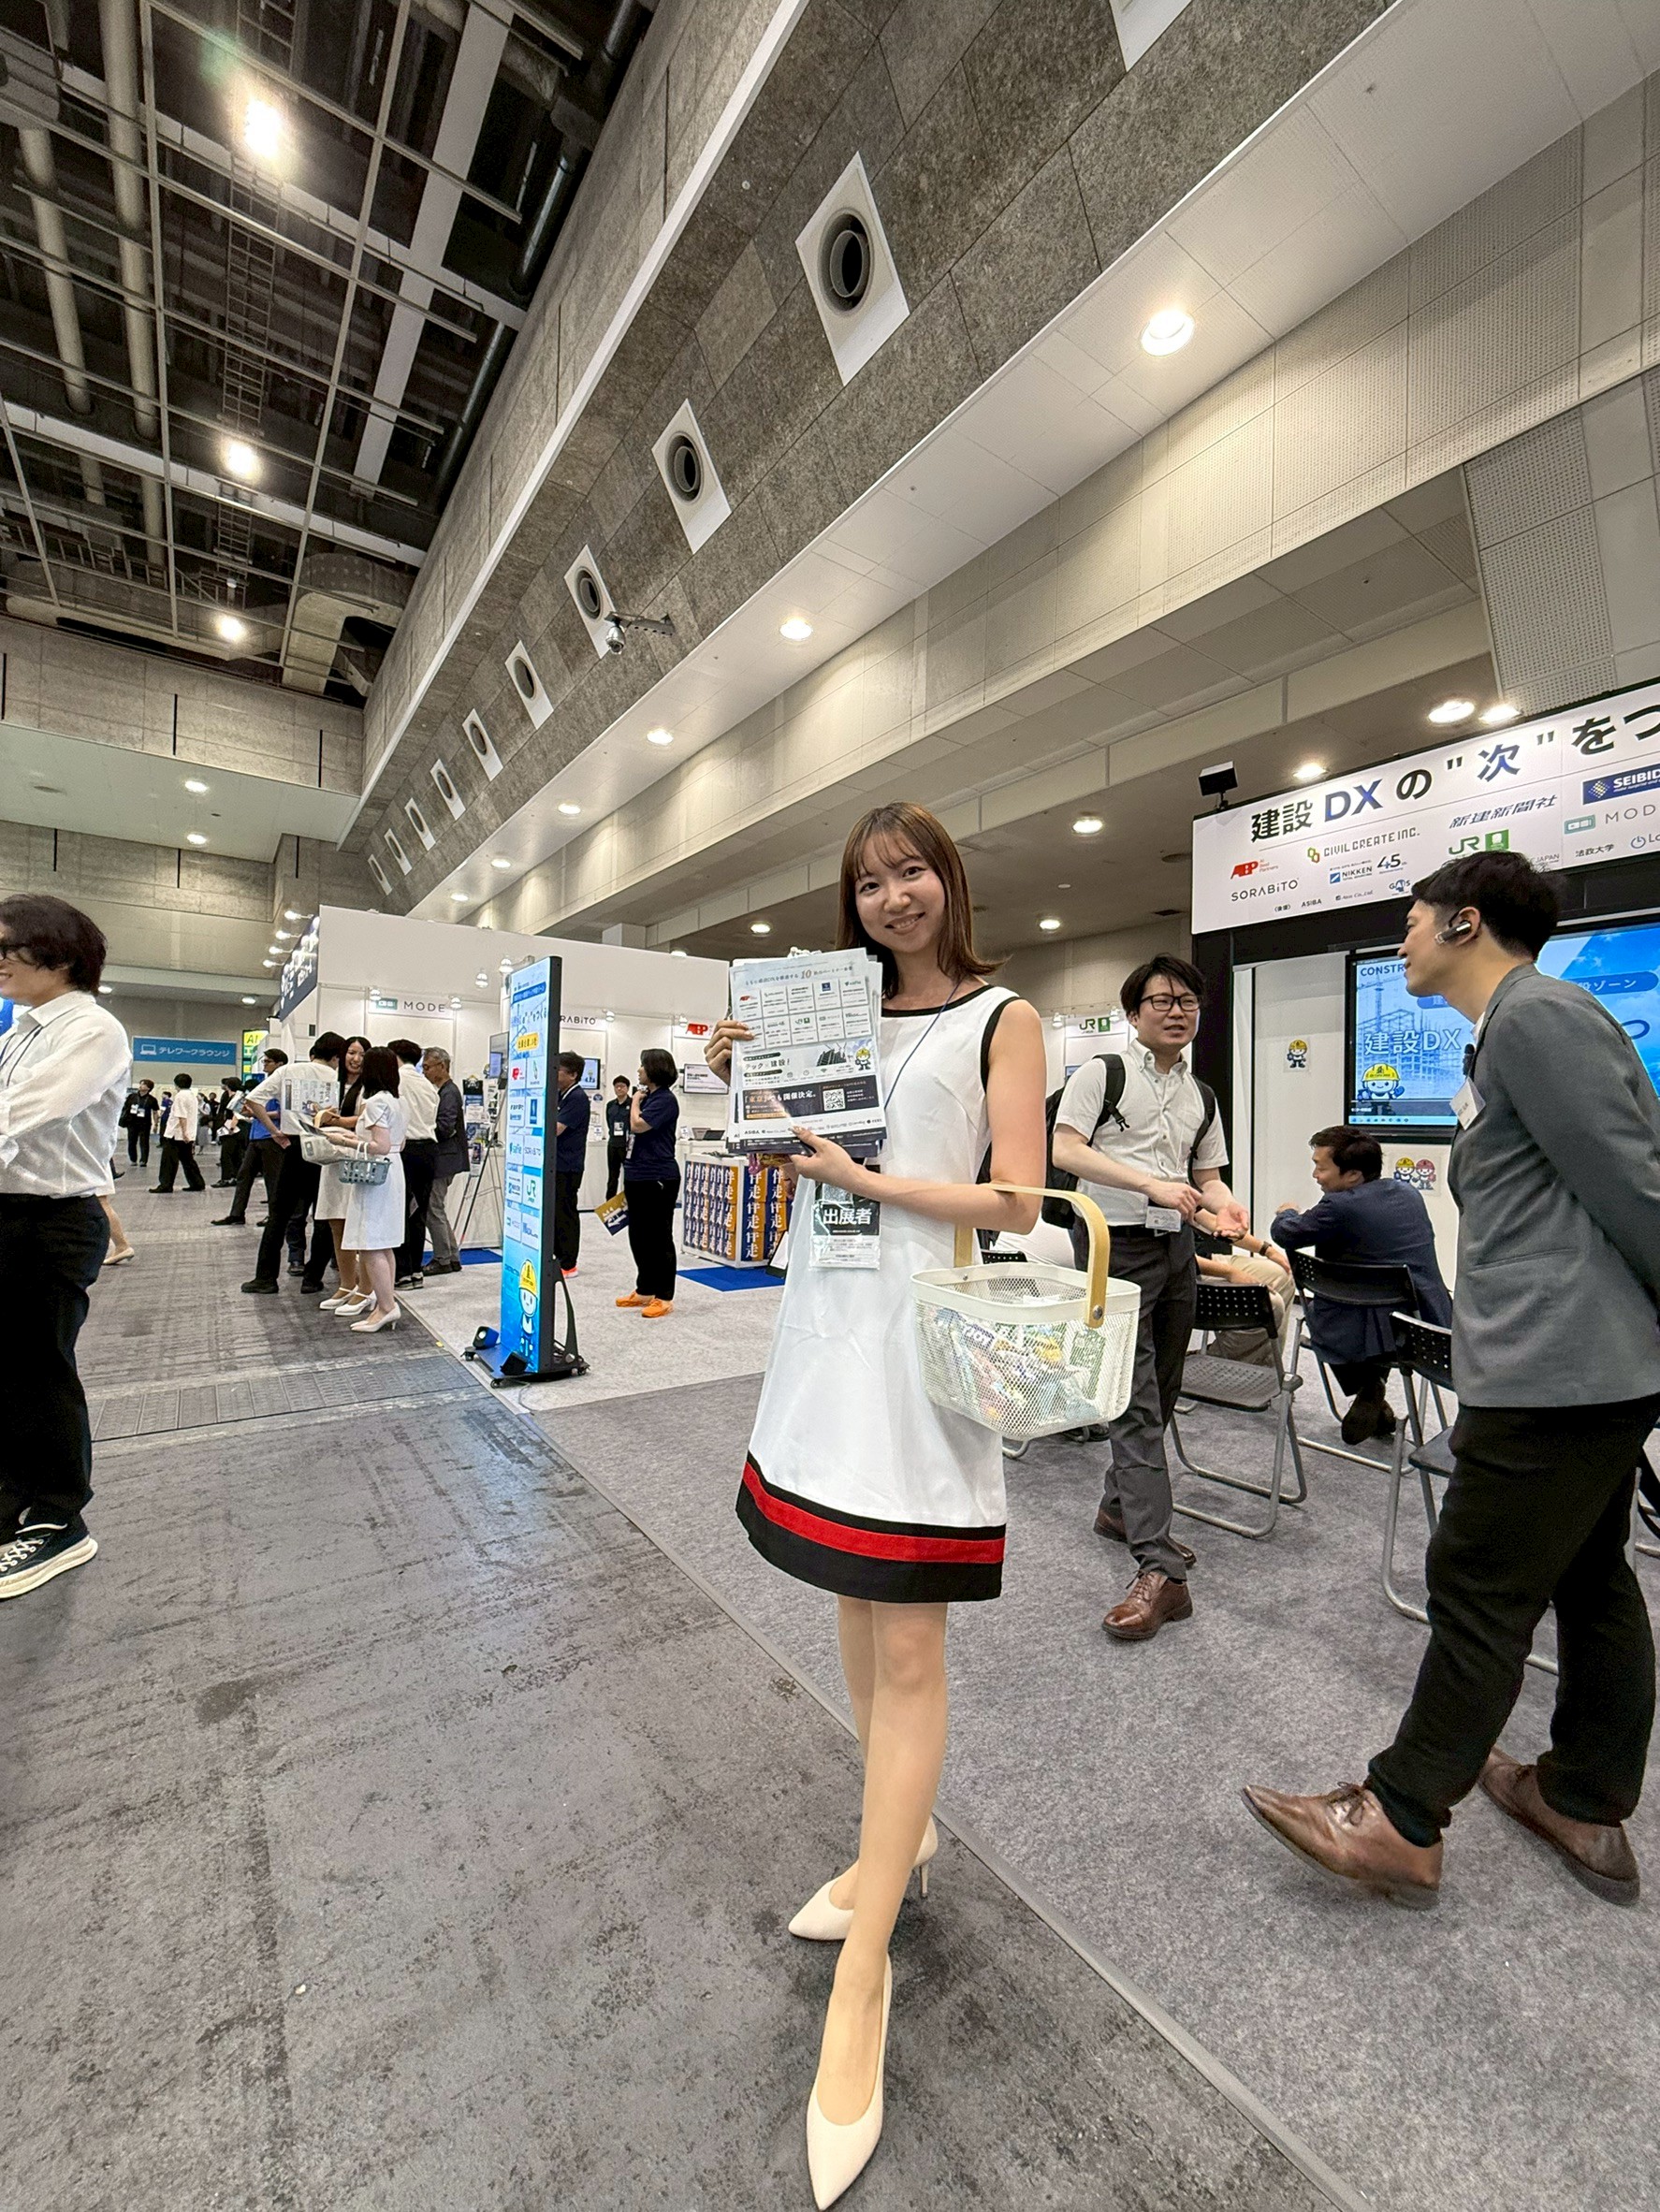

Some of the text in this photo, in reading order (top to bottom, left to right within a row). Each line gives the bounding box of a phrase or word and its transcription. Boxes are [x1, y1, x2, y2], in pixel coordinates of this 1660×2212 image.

[1251, 800, 1313, 842] 建設
[1325, 779, 1383, 822] DX
[1396, 769, 1433, 800] の
[1324, 827, 1420, 857] CIVIL CREATE INC.
[1449, 836, 1479, 854] JR
[1575, 844, 1614, 857] 法政大学
[1342, 866, 1373, 878] NIKKEN
[1302, 898, 1322, 908] ASIBA
[801, 969, 812, 980] 10
[403, 1001, 445, 1012] MODE
[1079, 1019, 1096, 1030] JR
[1364, 1029, 1462, 1055] 建設DX
[158, 1046, 230, 1057] テレワークラウンジ
[823, 1208, 872, 1225] 出展者
